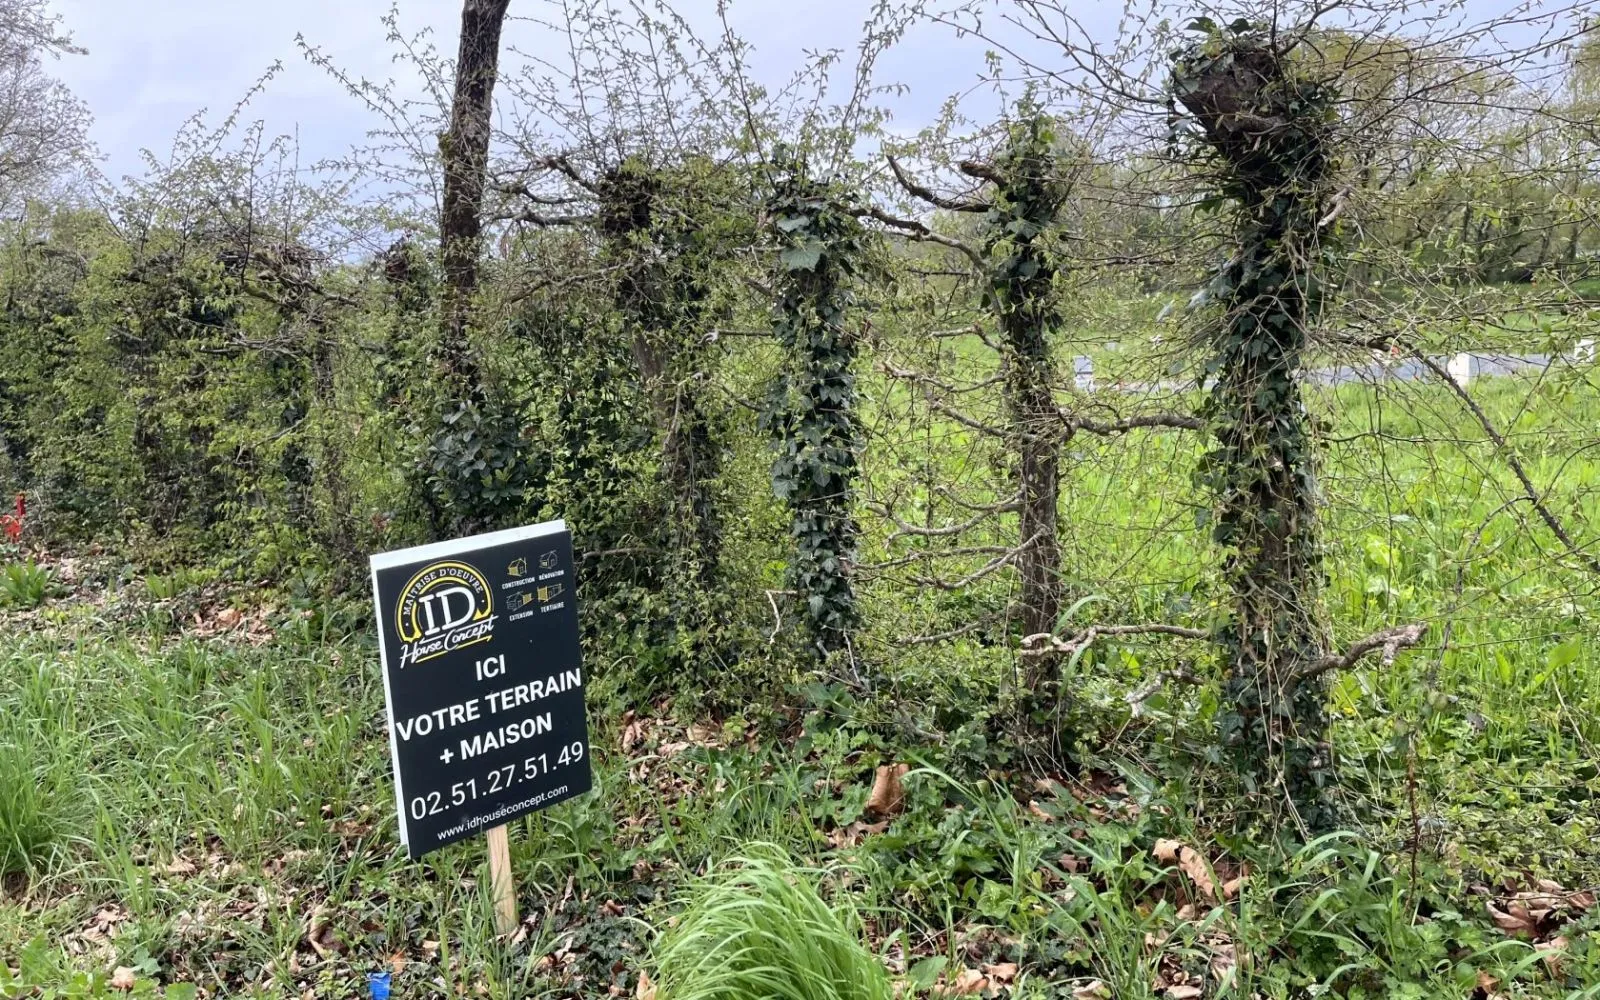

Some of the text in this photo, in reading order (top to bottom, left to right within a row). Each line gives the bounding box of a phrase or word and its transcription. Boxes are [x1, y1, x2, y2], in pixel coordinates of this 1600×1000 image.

[439, 567, 484, 594] D'OEUVRE
[502, 577, 535, 590] CONSTRUCTION
[418, 586, 476, 636] ID
[509, 610, 534, 622] EXTENSION
[540, 601, 565, 613] TERTIAIRE
[400, 615, 499, 669] House Concept
[475, 654, 506, 681] ICI
[396, 667, 582, 742] VOTRE TERRAIN
[439, 712, 553, 764] + MAISON
[411, 741, 584, 820] 02.51.27.51.49
[437, 784, 568, 841] www.idhouseconcept.com
